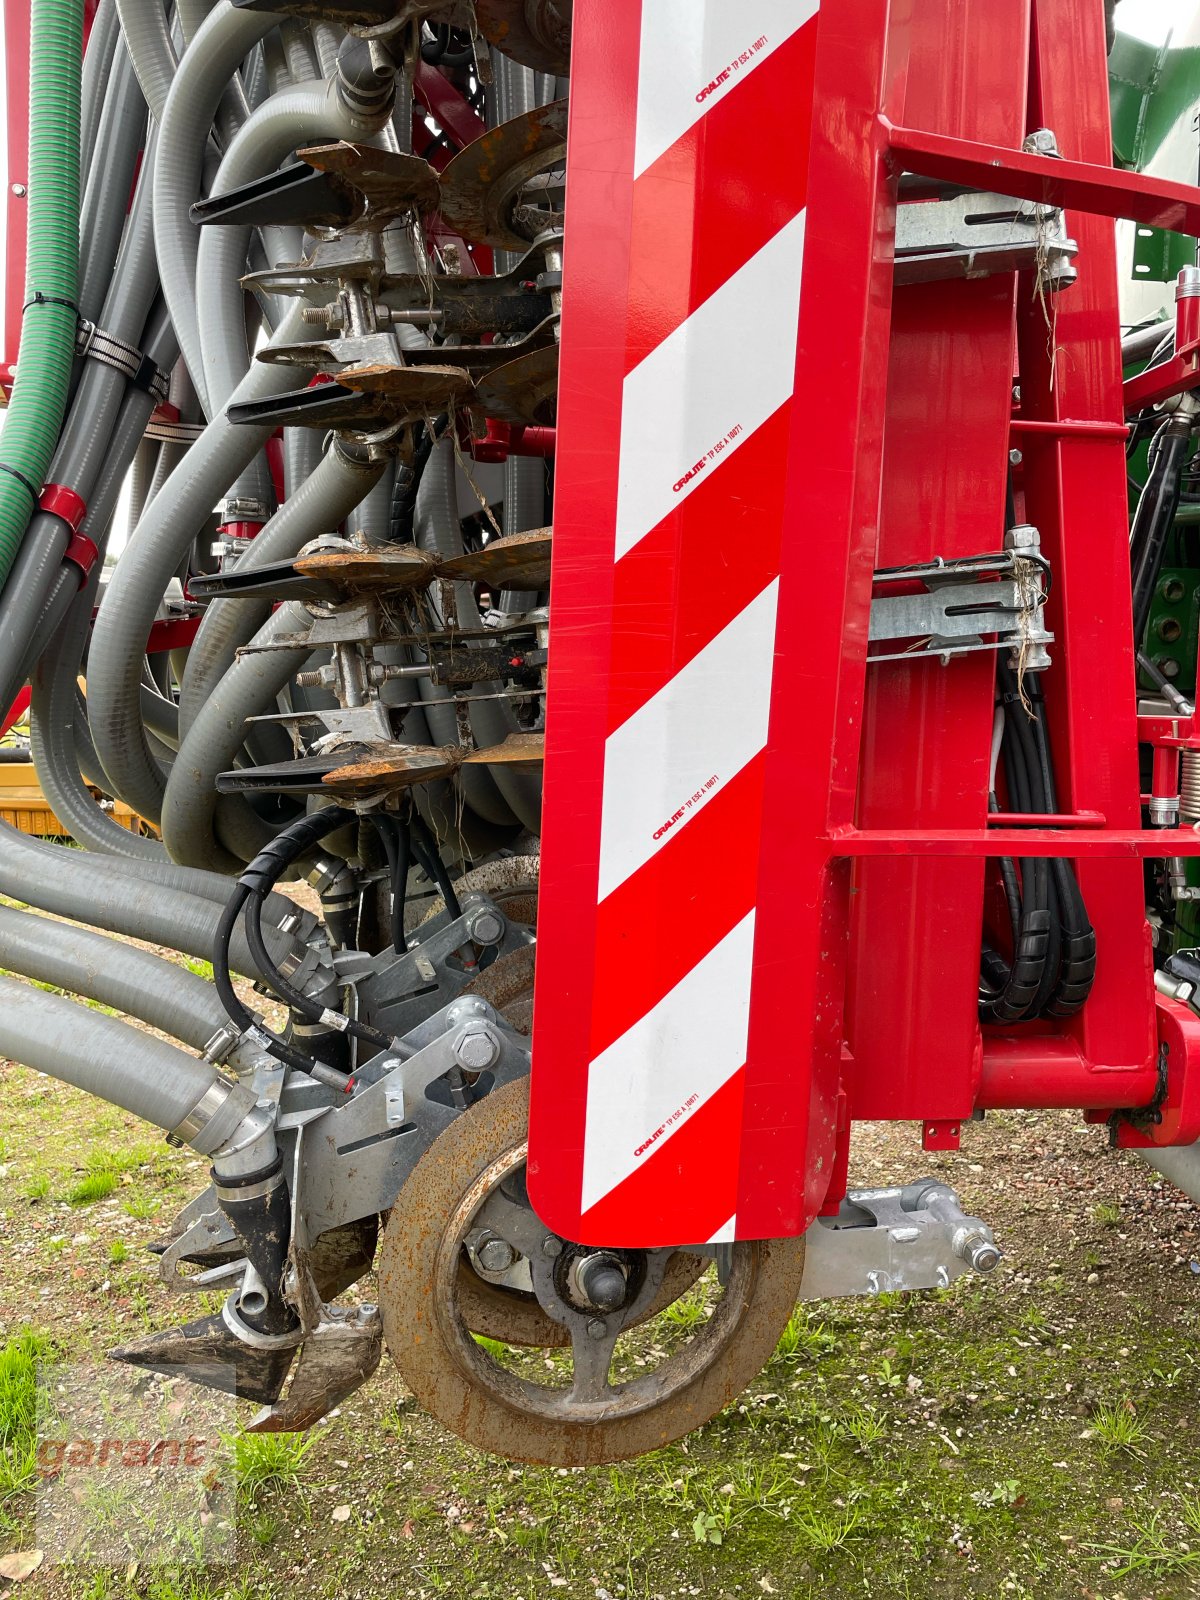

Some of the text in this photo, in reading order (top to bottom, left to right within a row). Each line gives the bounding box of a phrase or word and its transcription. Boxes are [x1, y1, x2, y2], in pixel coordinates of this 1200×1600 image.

[731, 60, 739, 70] TP
[738, 52, 749, 65] ESC
[748, 48, 754, 57] A
[752, 35, 768, 52] 10071
[707, 450, 715, 459] TP
[714, 441, 725, 453] ESC
[727, 424, 743, 440] 10071
[685, 800, 693, 808] TP
[691, 791, 702, 803] ESC
[704, 775, 719, 789] 10071
[672, 1109, 683, 1120] ESC
